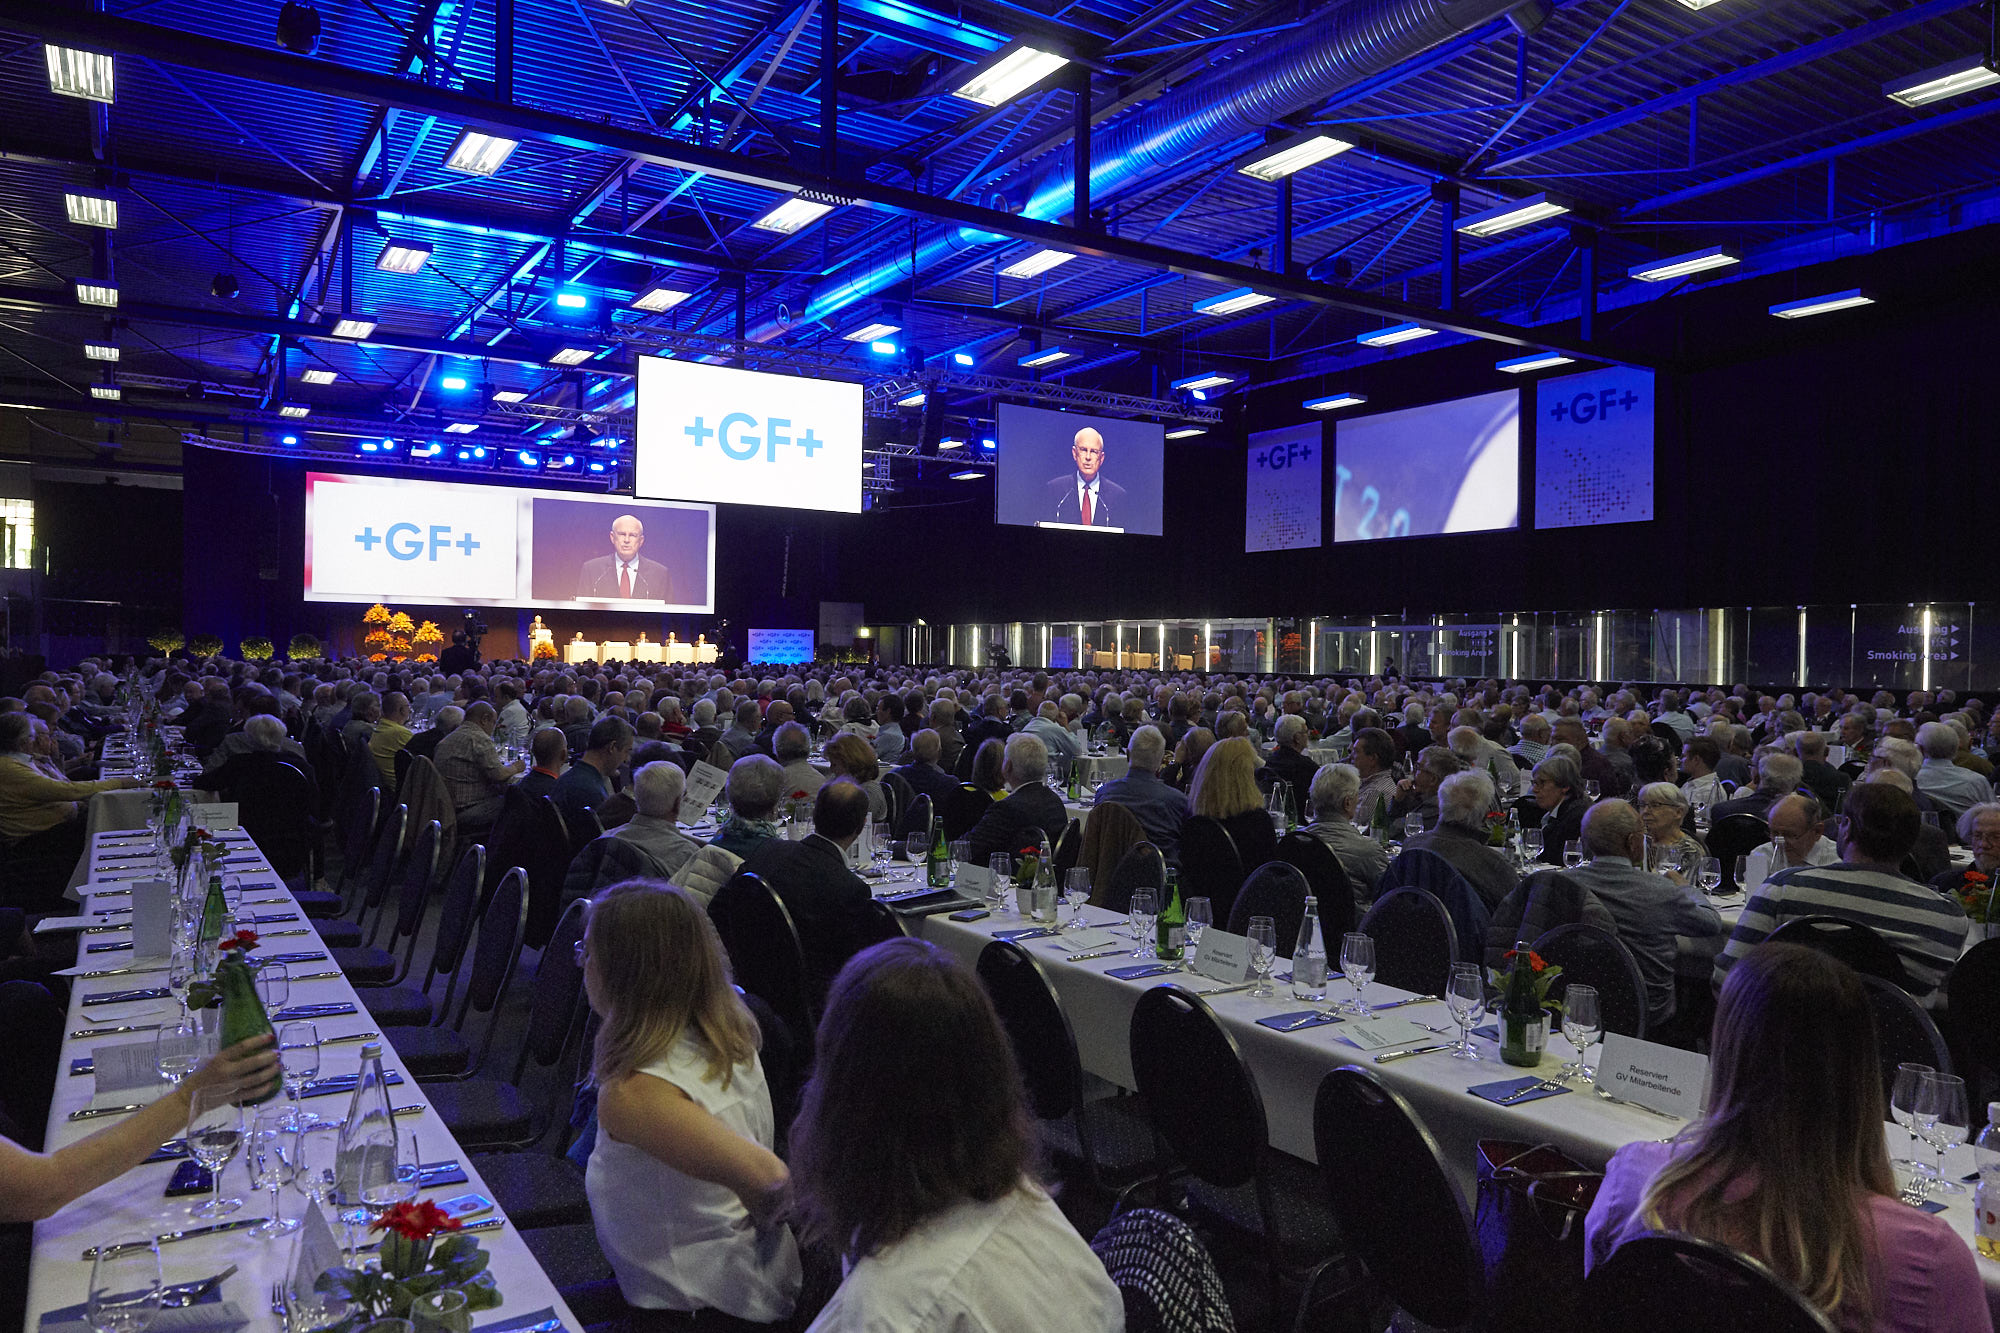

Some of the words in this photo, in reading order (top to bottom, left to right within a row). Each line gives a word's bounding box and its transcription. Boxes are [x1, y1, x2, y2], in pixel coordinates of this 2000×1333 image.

[684, 411, 824, 463] +GF+
[354, 521, 481, 562] +GF+
[1897, 624, 1949, 636] Ausng
[1867, 650, 1917, 662] Smoking
[1629, 1064, 1669, 1082] Reserviert
[1615, 1072, 1629, 1081] GV
[1629, 1075, 1682, 1096] Mitarbeitende
